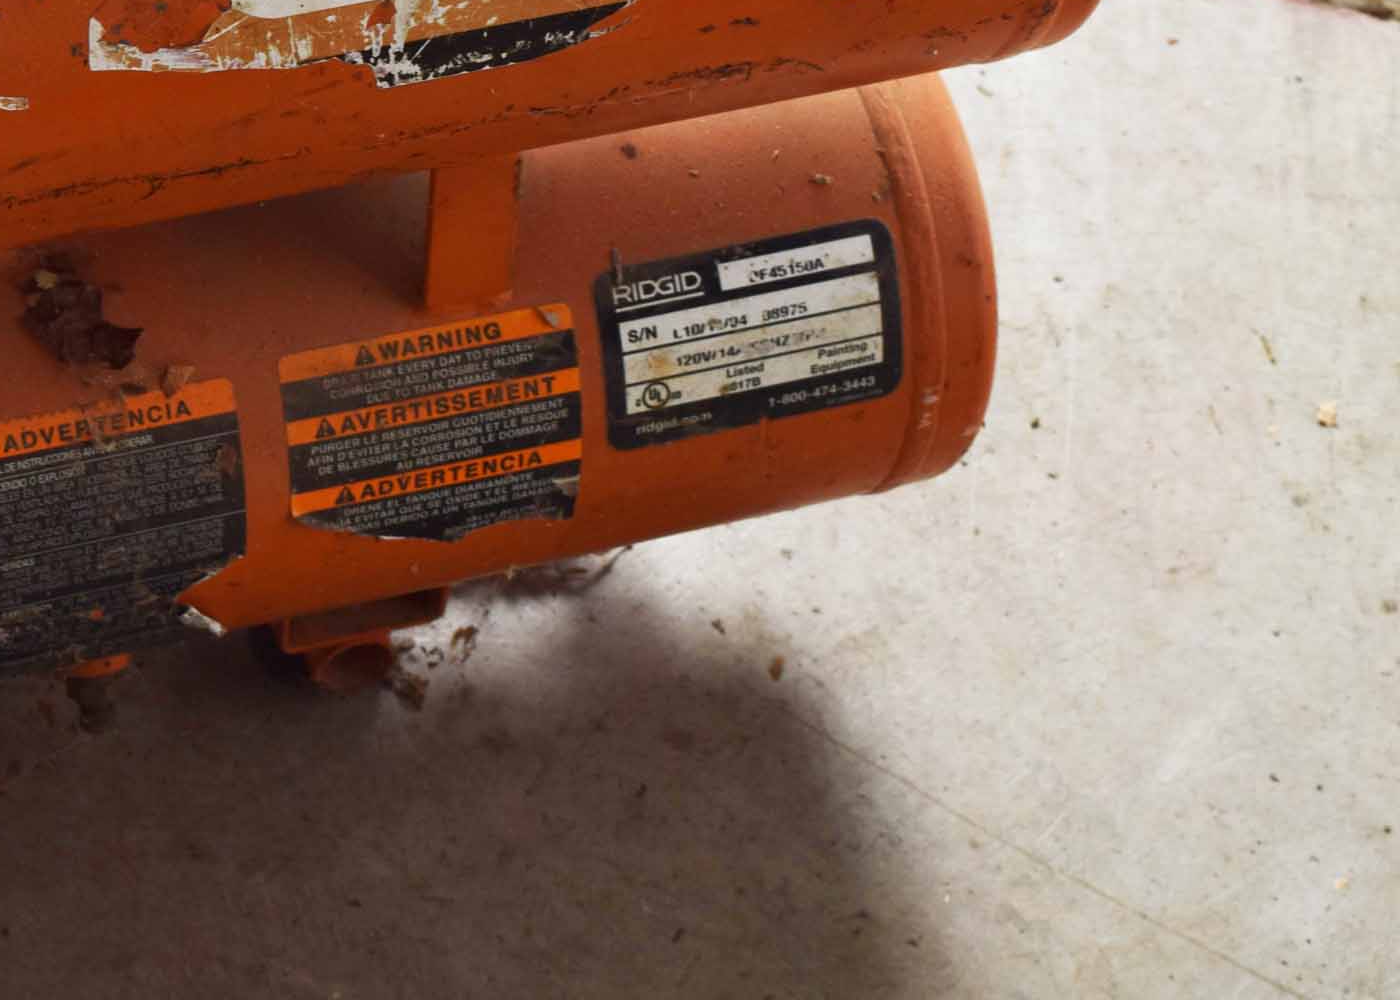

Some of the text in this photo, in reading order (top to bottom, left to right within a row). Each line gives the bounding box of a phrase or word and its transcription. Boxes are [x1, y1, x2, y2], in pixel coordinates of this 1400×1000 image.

[611, 271, 702, 304] RIDGID
[377, 322, 502, 361] WARNING
[627, 324, 658, 344] S/N
[439, 354, 461, 366] DAY
[466, 350, 481, 361] TO
[483, 340, 534, 357] PREVEN
[725, 362, 766, 379] Listed
[340, 376, 557, 434] AVERTISSEMENT
[3, 400, 192, 453] ADVERTENCIA
[360, 451, 543, 500] ADVERTENCIA
